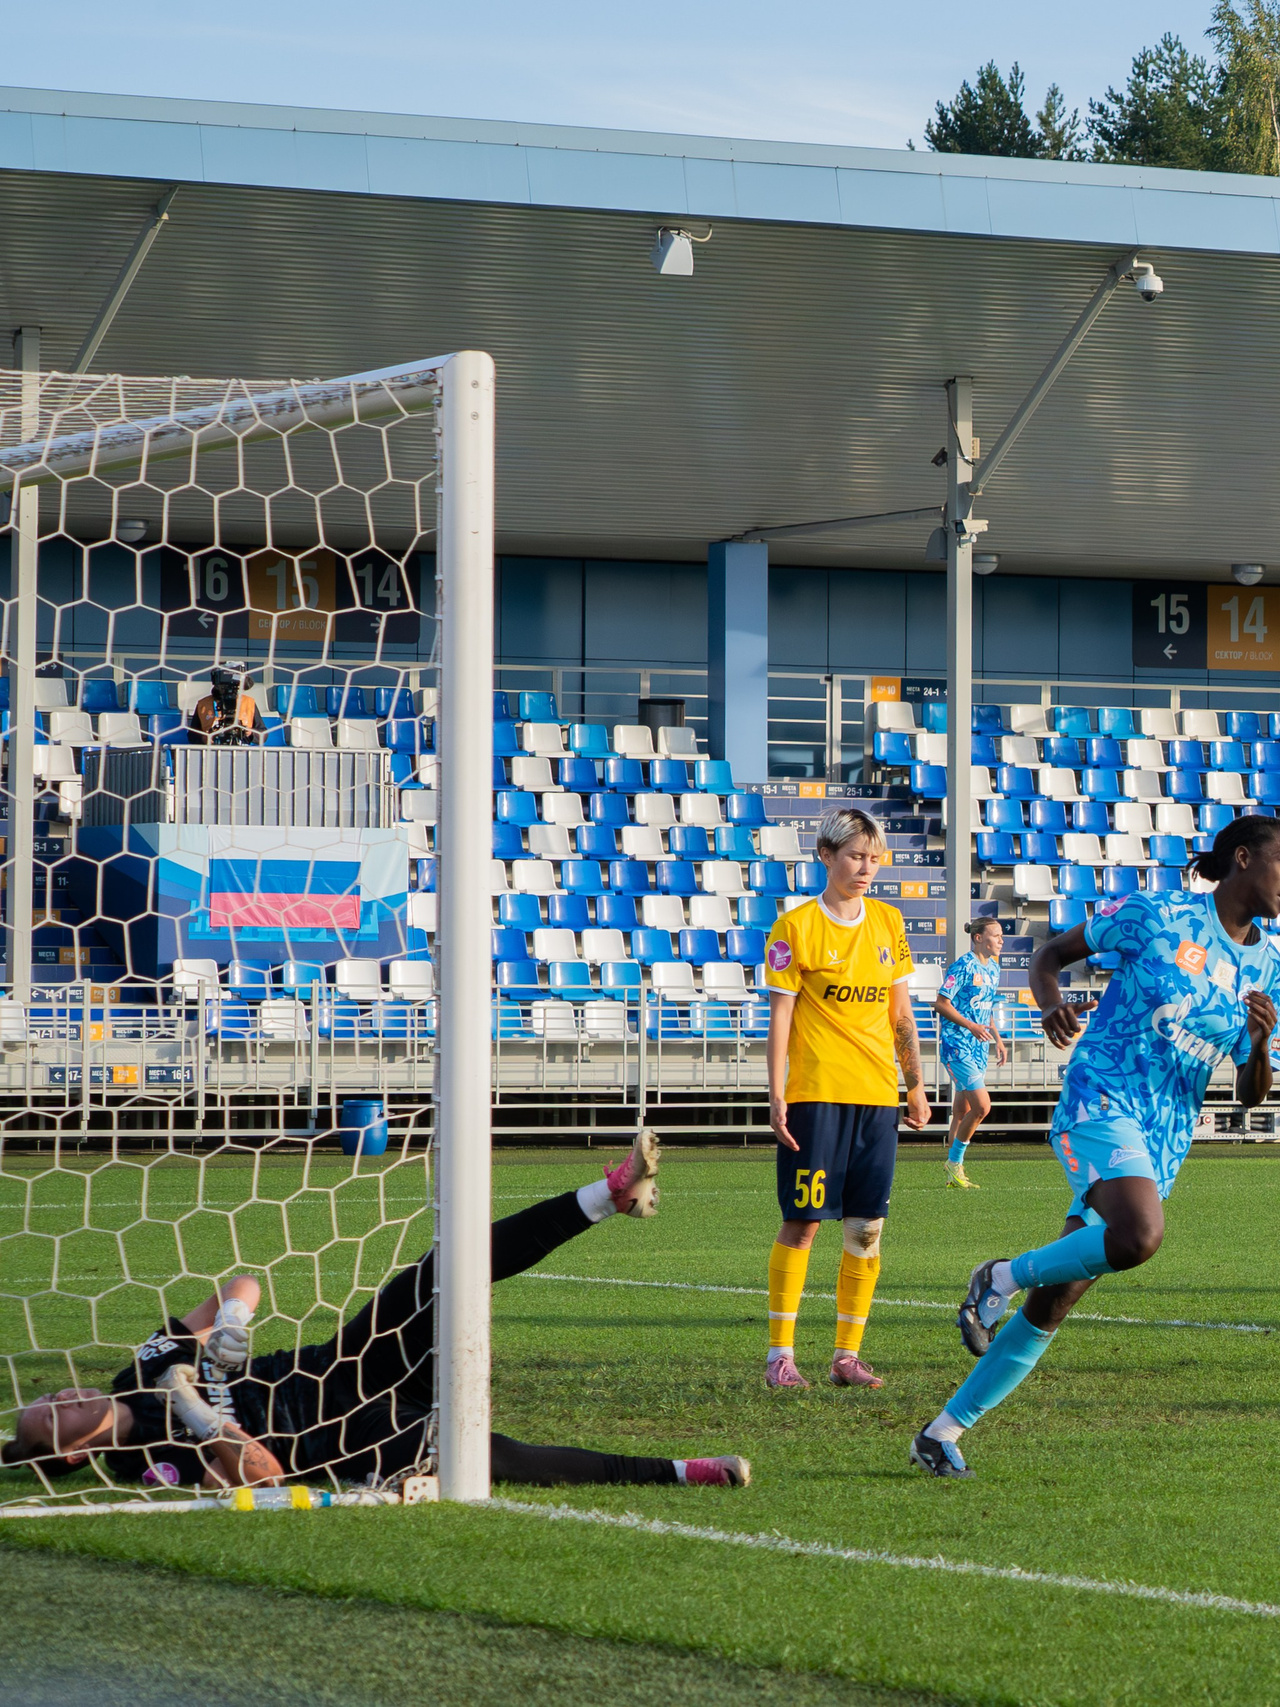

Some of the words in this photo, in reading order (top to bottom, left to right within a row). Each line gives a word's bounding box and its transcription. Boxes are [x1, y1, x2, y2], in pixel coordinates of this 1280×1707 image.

[266, 559, 320, 610] 15
[356, 563, 401, 606] 14
[1150, 593, 1190, 635] 15
[1221, 595, 1268, 643] 14
[258, 619, 291, 630] СЕКОР
[1214, 650, 1243, 660] СЕКТОР
[1249, 651, 1274, 661] BLOCK
[887, 685, 896, 695] 10
[923, 687, 939, 696] 24-1
[762, 785, 778, 794] 15-1
[816, 786, 822, 796] 9
[847, 787, 863, 796] 25-1
[34, 842, 47, 852] 5-1
[913, 854, 930, 863] 25-1
[57, 877, 69, 886] 11-
[918, 886, 923, 895] 6
[933, 956, 947, 965] 11-
[110, 990, 116, 1000] 3
[823, 984, 890, 1004] FONBE
[1067, 993, 1085, 1003] 25-1
[68, 1070, 82, 1080] 17-
[793, 1168, 827, 1209] 56
